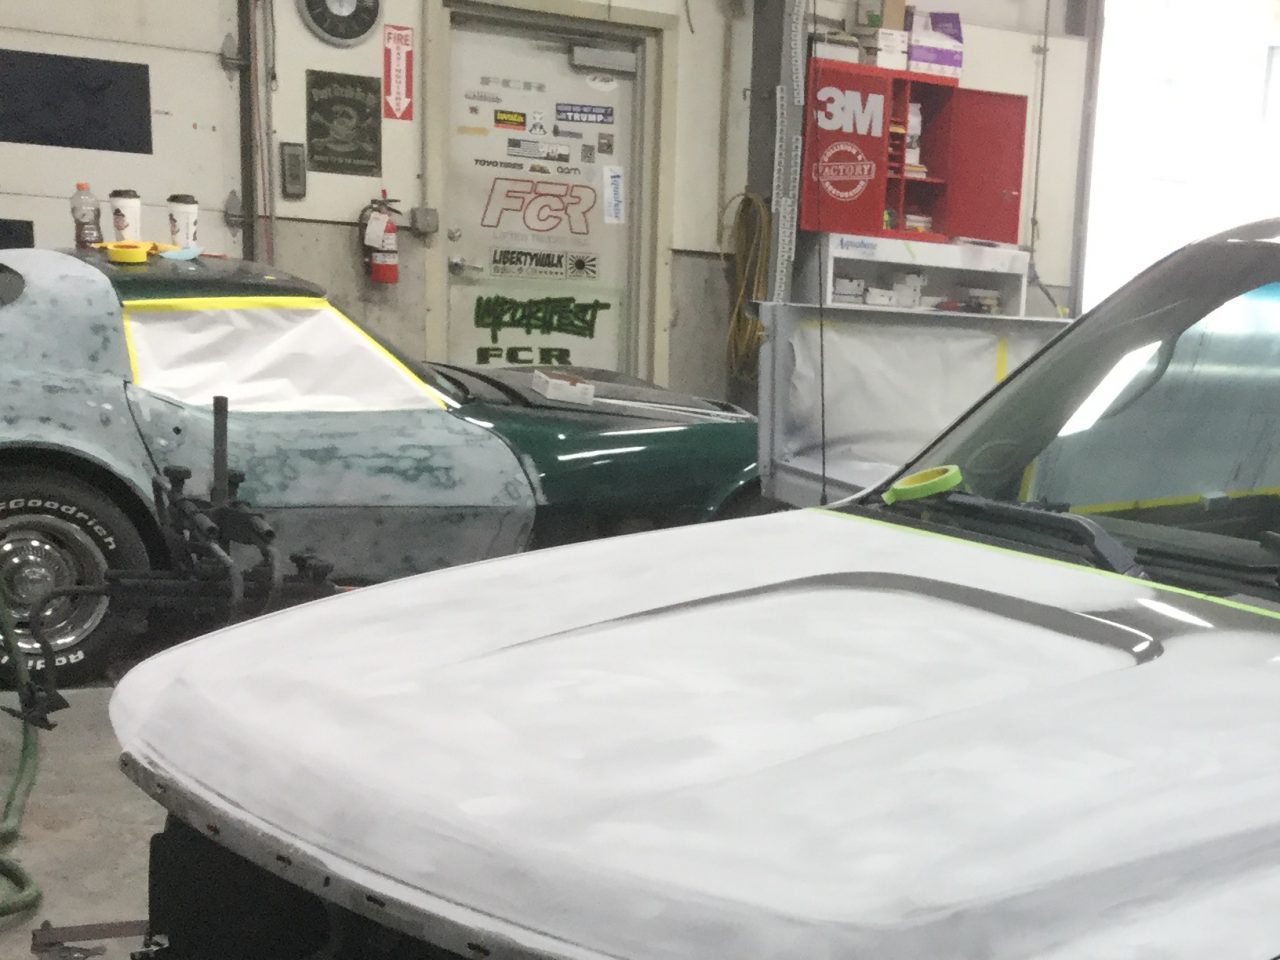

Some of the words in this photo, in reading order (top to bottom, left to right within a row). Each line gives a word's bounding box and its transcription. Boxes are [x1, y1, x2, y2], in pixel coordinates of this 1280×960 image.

[387, 32, 410, 46] FIRE
[566, 112, 604, 122] TRUMP
[815, 86, 884, 137] 3M
[474, 158, 499, 168] TOYO
[499, 161, 524, 170] TIRES
[480, 177, 597, 236] FCR
[492, 250, 565, 269] LIBERTYWALK
[476, 347, 572, 365] FCR
